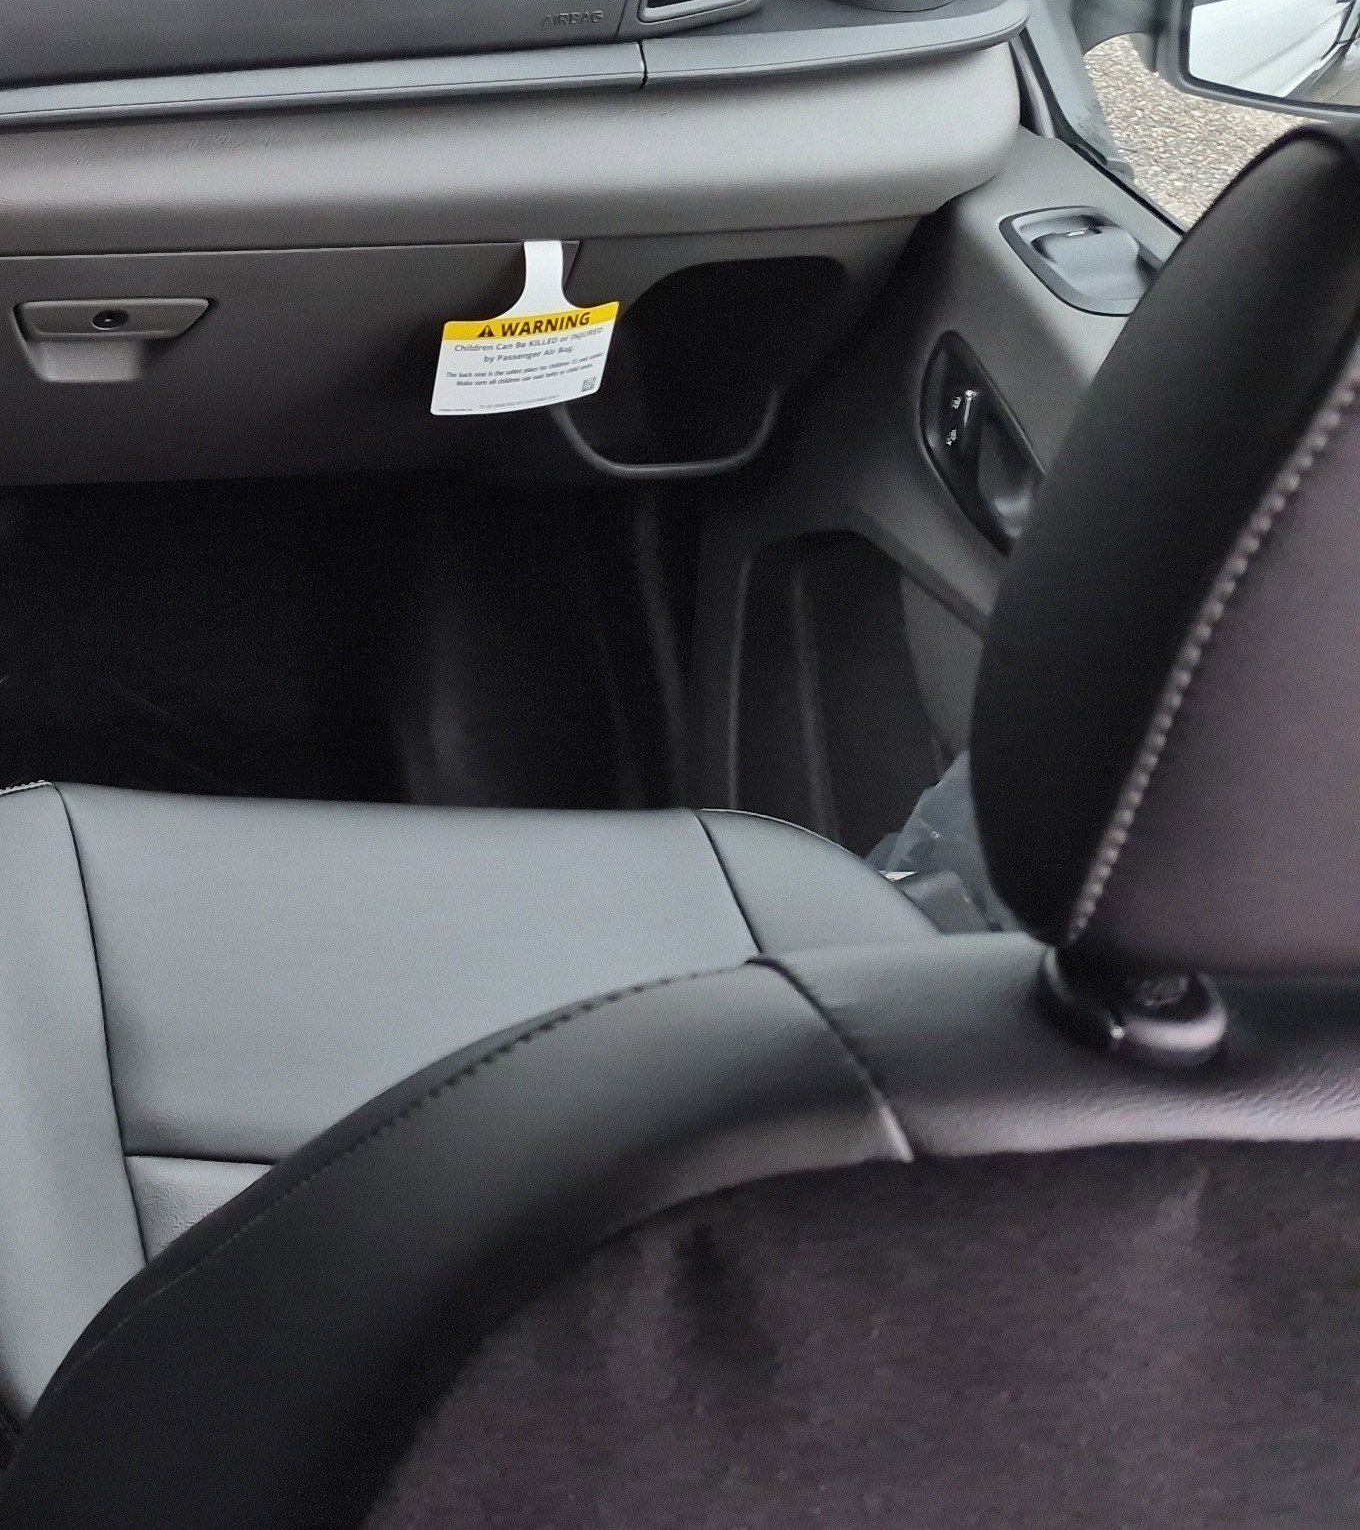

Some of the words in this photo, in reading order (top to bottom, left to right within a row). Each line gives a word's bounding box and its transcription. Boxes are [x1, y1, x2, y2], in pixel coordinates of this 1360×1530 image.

[542, 10, 603, 27] AIRBAG
[501, 312, 591, 337] WARNING
[454, 344, 494, 352] Children
[496, 343, 513, 351] Can
[528, 336, 558, 348] KILLED
[570, 327, 604, 341] INJURED
[484, 354, 495, 363] by
[497, 351, 541, 362] Passenger
[543, 347, 555, 356] Air
